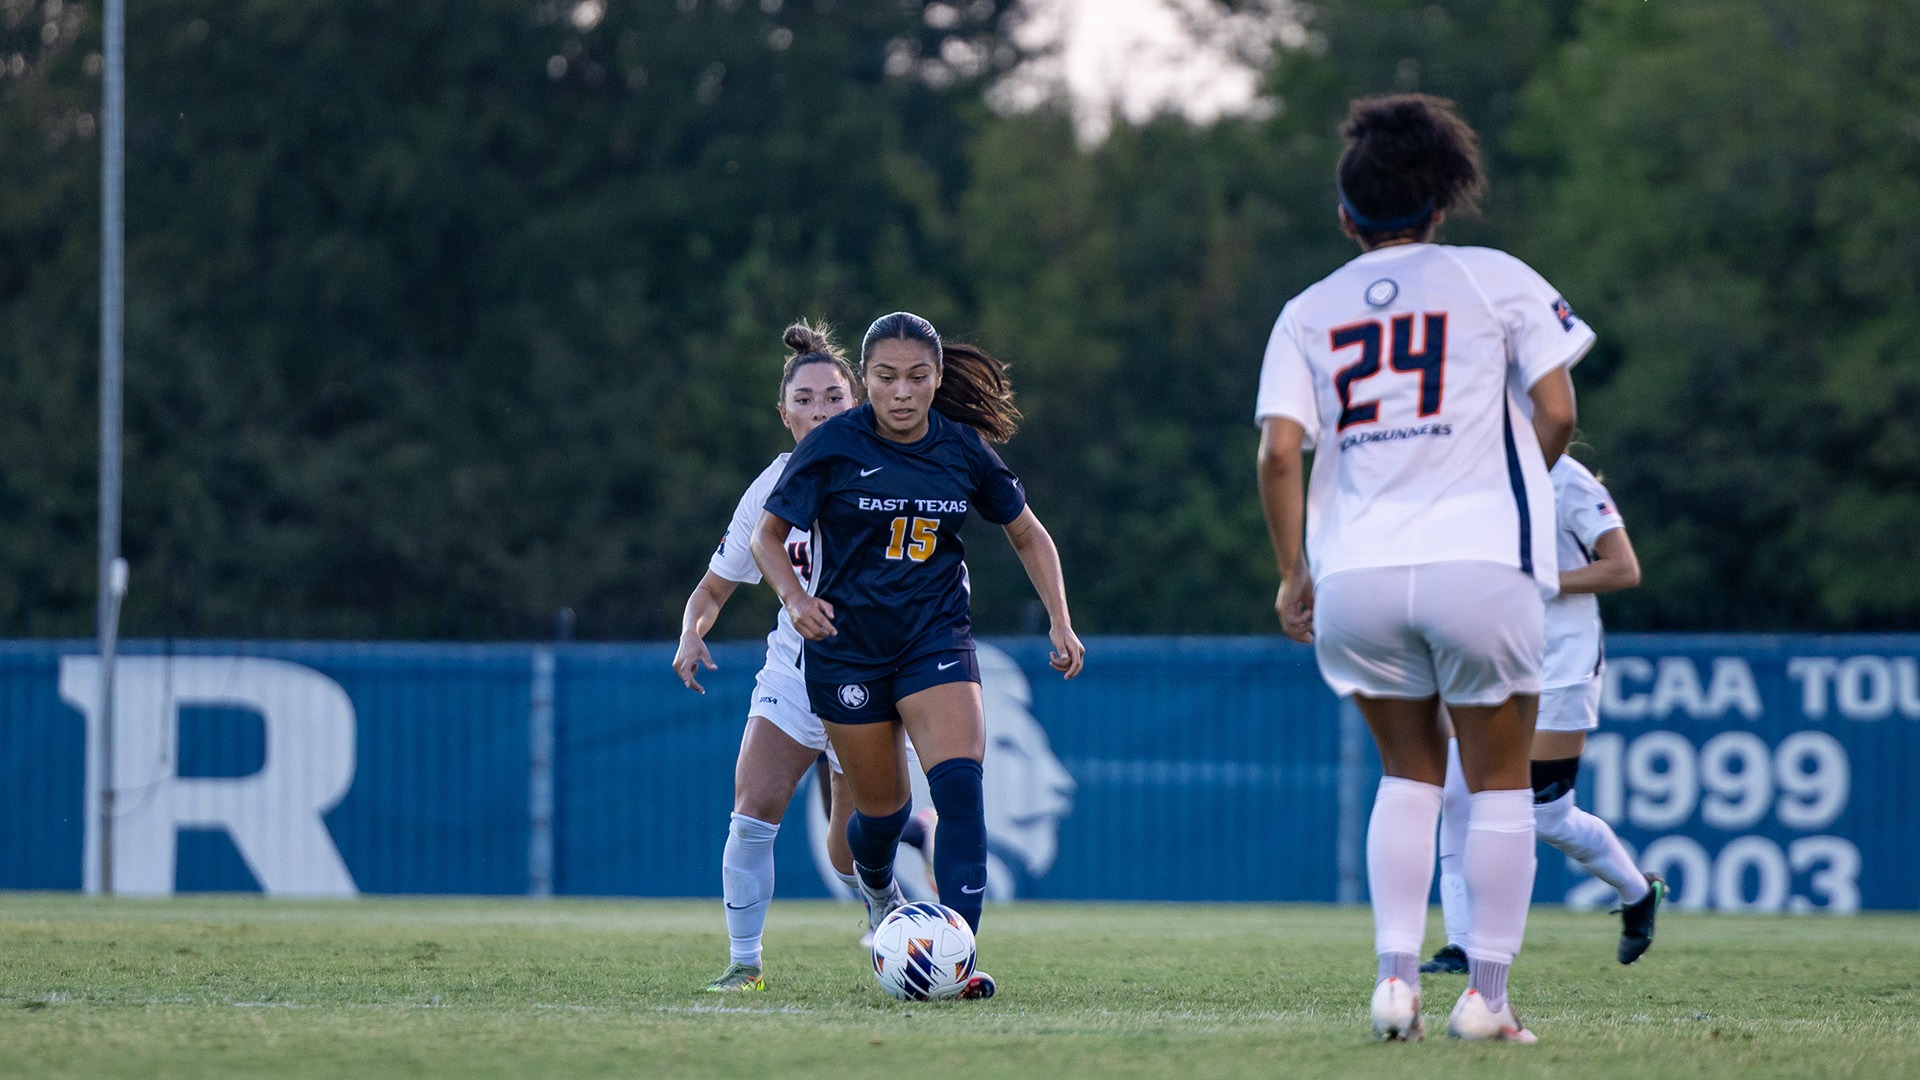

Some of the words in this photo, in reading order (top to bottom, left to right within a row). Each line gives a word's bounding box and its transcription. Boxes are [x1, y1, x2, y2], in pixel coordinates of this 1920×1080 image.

[1329, 311, 1448, 433] 24
[1339, 423, 1453, 452] OADRUNNERS
[858, 497, 908, 511] EAST
[915, 499, 967, 513] TEXAS
[885, 516, 941, 562] 15
[1600, 656, 1762, 720] CAA
[58, 655, 361, 895] R
[1580, 730, 1851, 830] 1999
